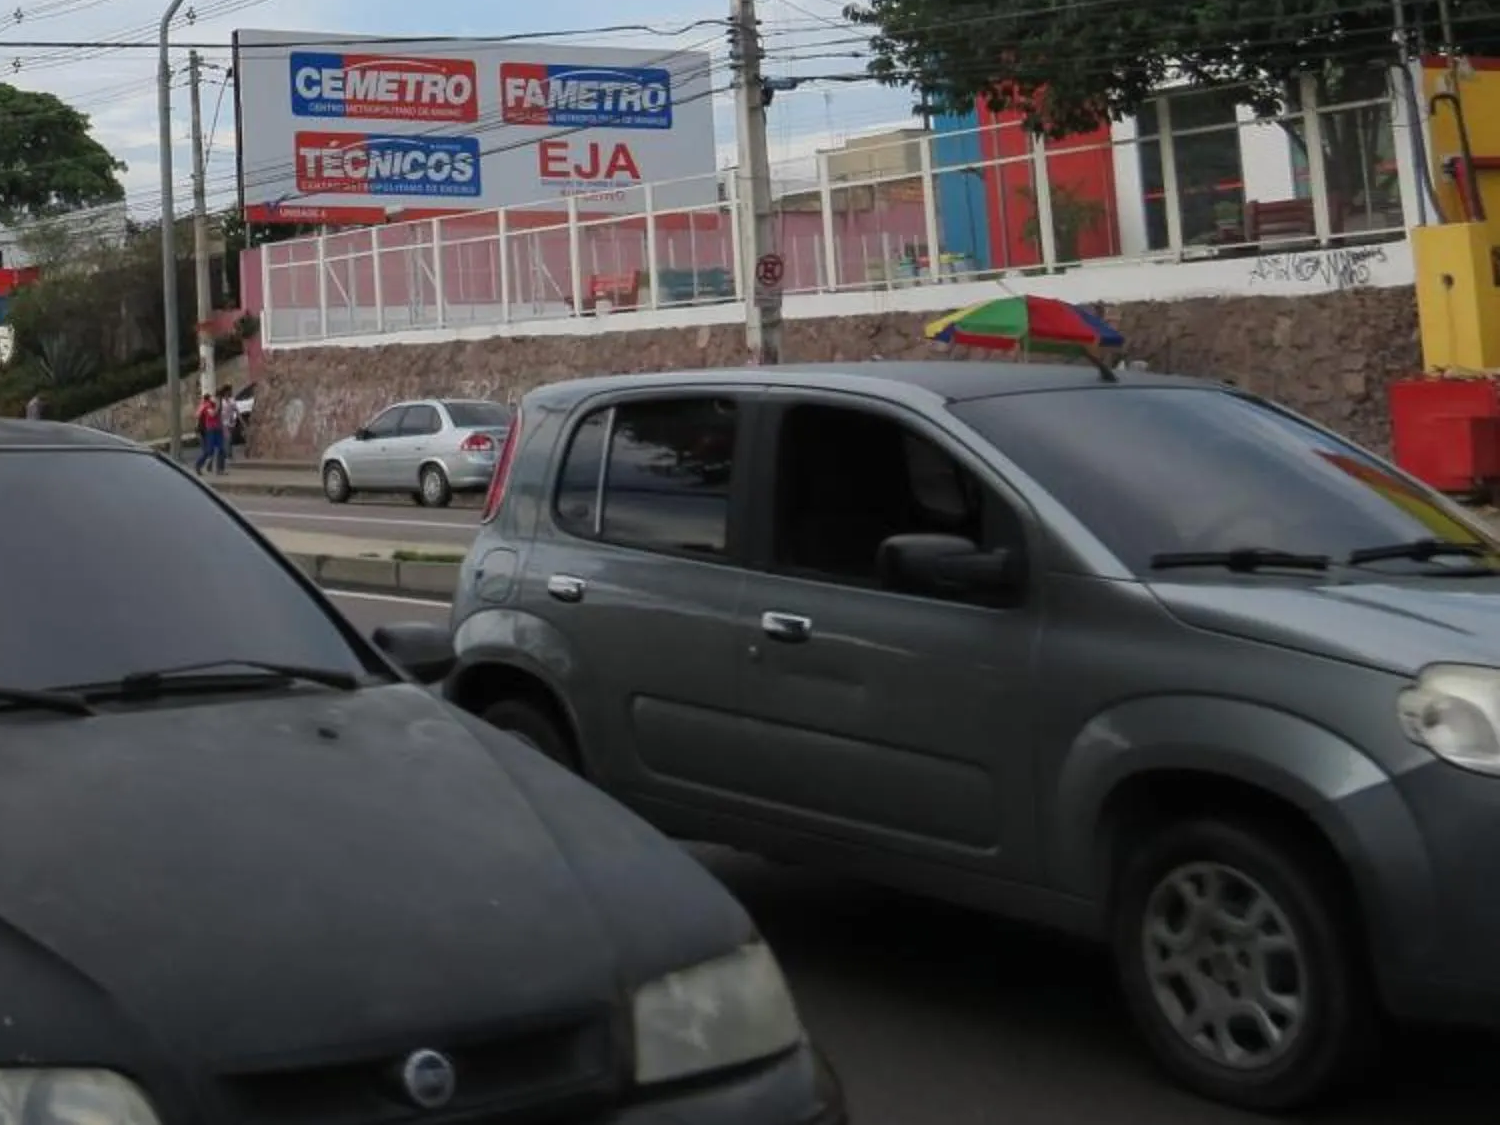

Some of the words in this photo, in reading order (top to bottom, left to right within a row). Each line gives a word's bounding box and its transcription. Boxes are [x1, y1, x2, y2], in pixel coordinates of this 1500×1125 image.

[295, 66, 472, 105] CEMETRO
[505, 77, 667, 113] FAMETRO
[299, 140, 475, 182] TÉCNICOS
[539, 140, 641, 180] EJA
